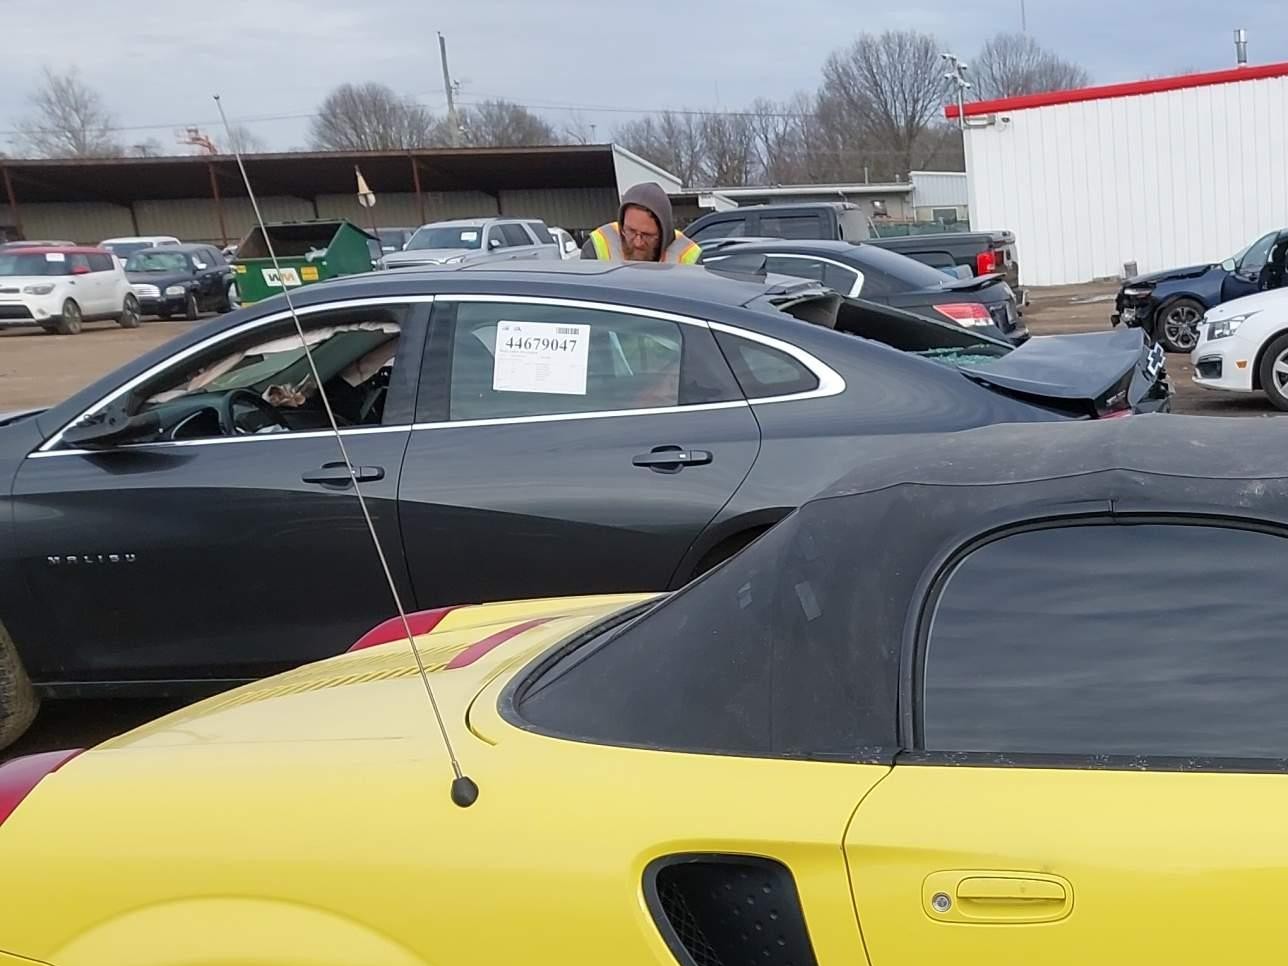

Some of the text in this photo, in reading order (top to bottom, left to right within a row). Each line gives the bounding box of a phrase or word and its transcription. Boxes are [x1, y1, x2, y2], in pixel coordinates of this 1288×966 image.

[268, 273, 294, 282] WM
[505, 337, 577, 352] 44679047
[47, 553, 136, 564] MALIBU
